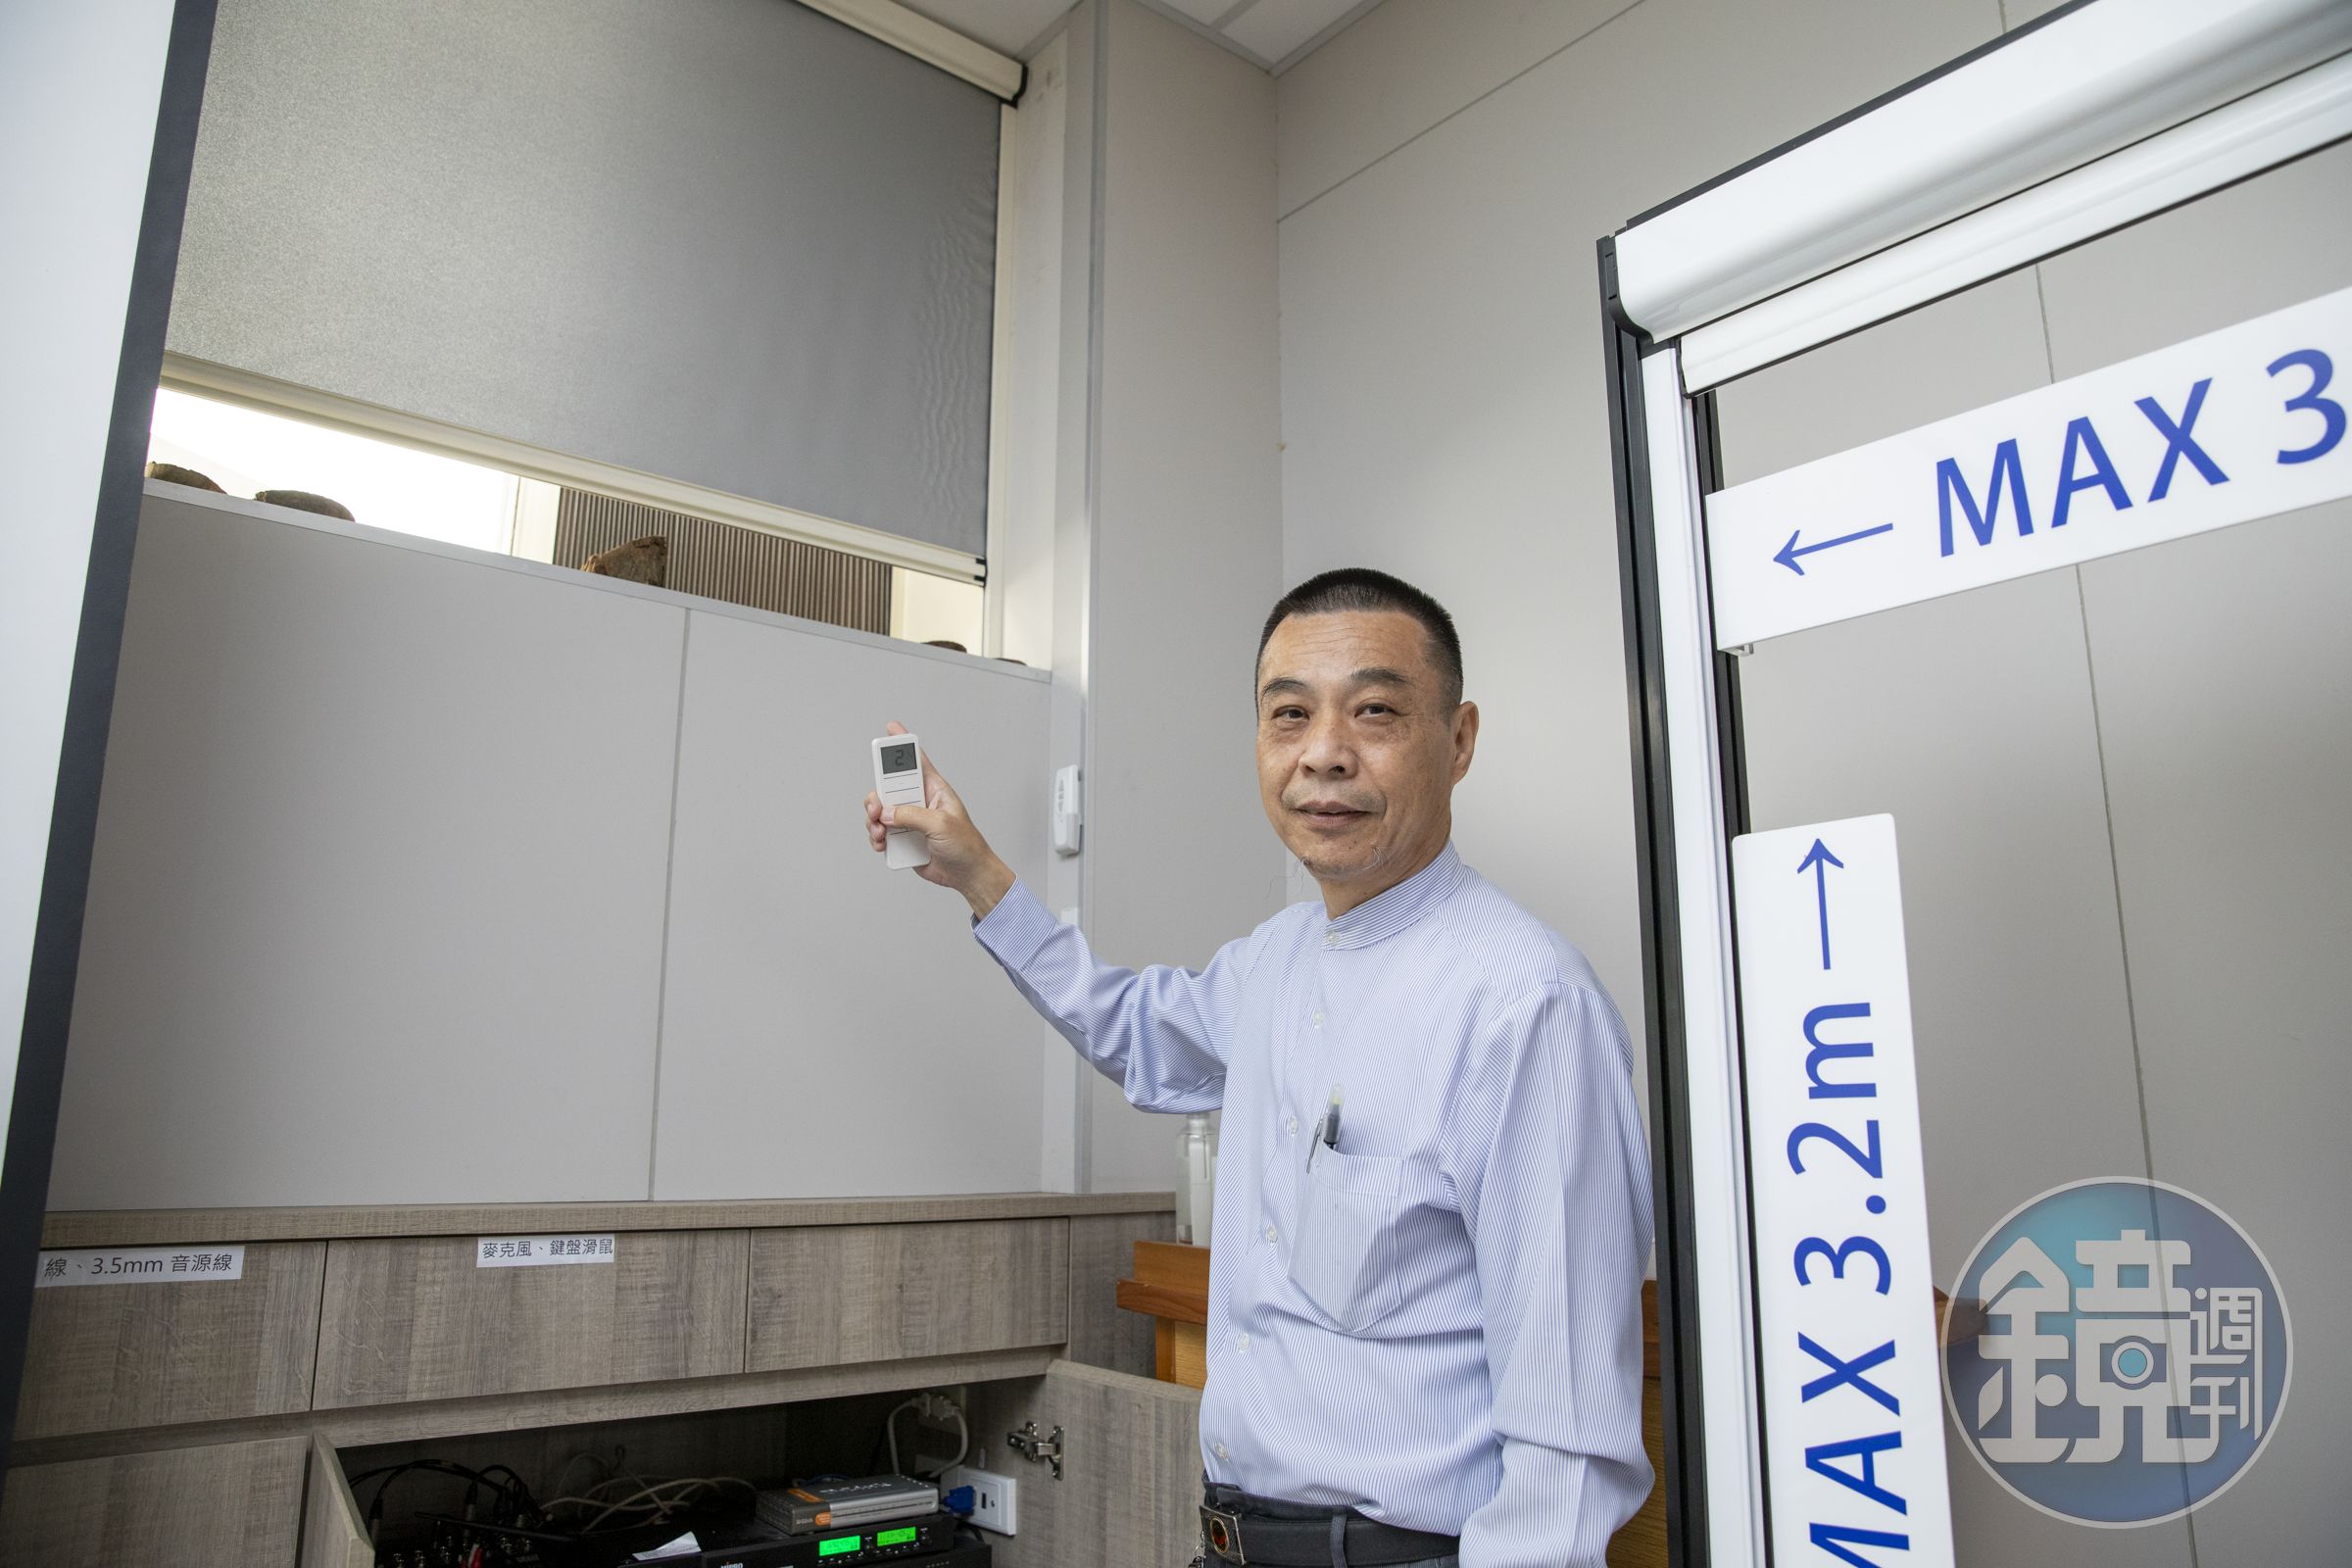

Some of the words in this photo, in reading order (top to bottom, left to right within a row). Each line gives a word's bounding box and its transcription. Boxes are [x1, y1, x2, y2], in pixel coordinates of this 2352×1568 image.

[1936, 377, 2230, 558] MAX
[2266, 349, 2347, 465] 3
[894, 749, 904, 766] 2
[1787, 1002, 1892, 1297] 3.2m
[482, 1239, 613, 1258] 麥克風、鍵盤滑鼠
[171, 1253, 233, 1272] 音源線
